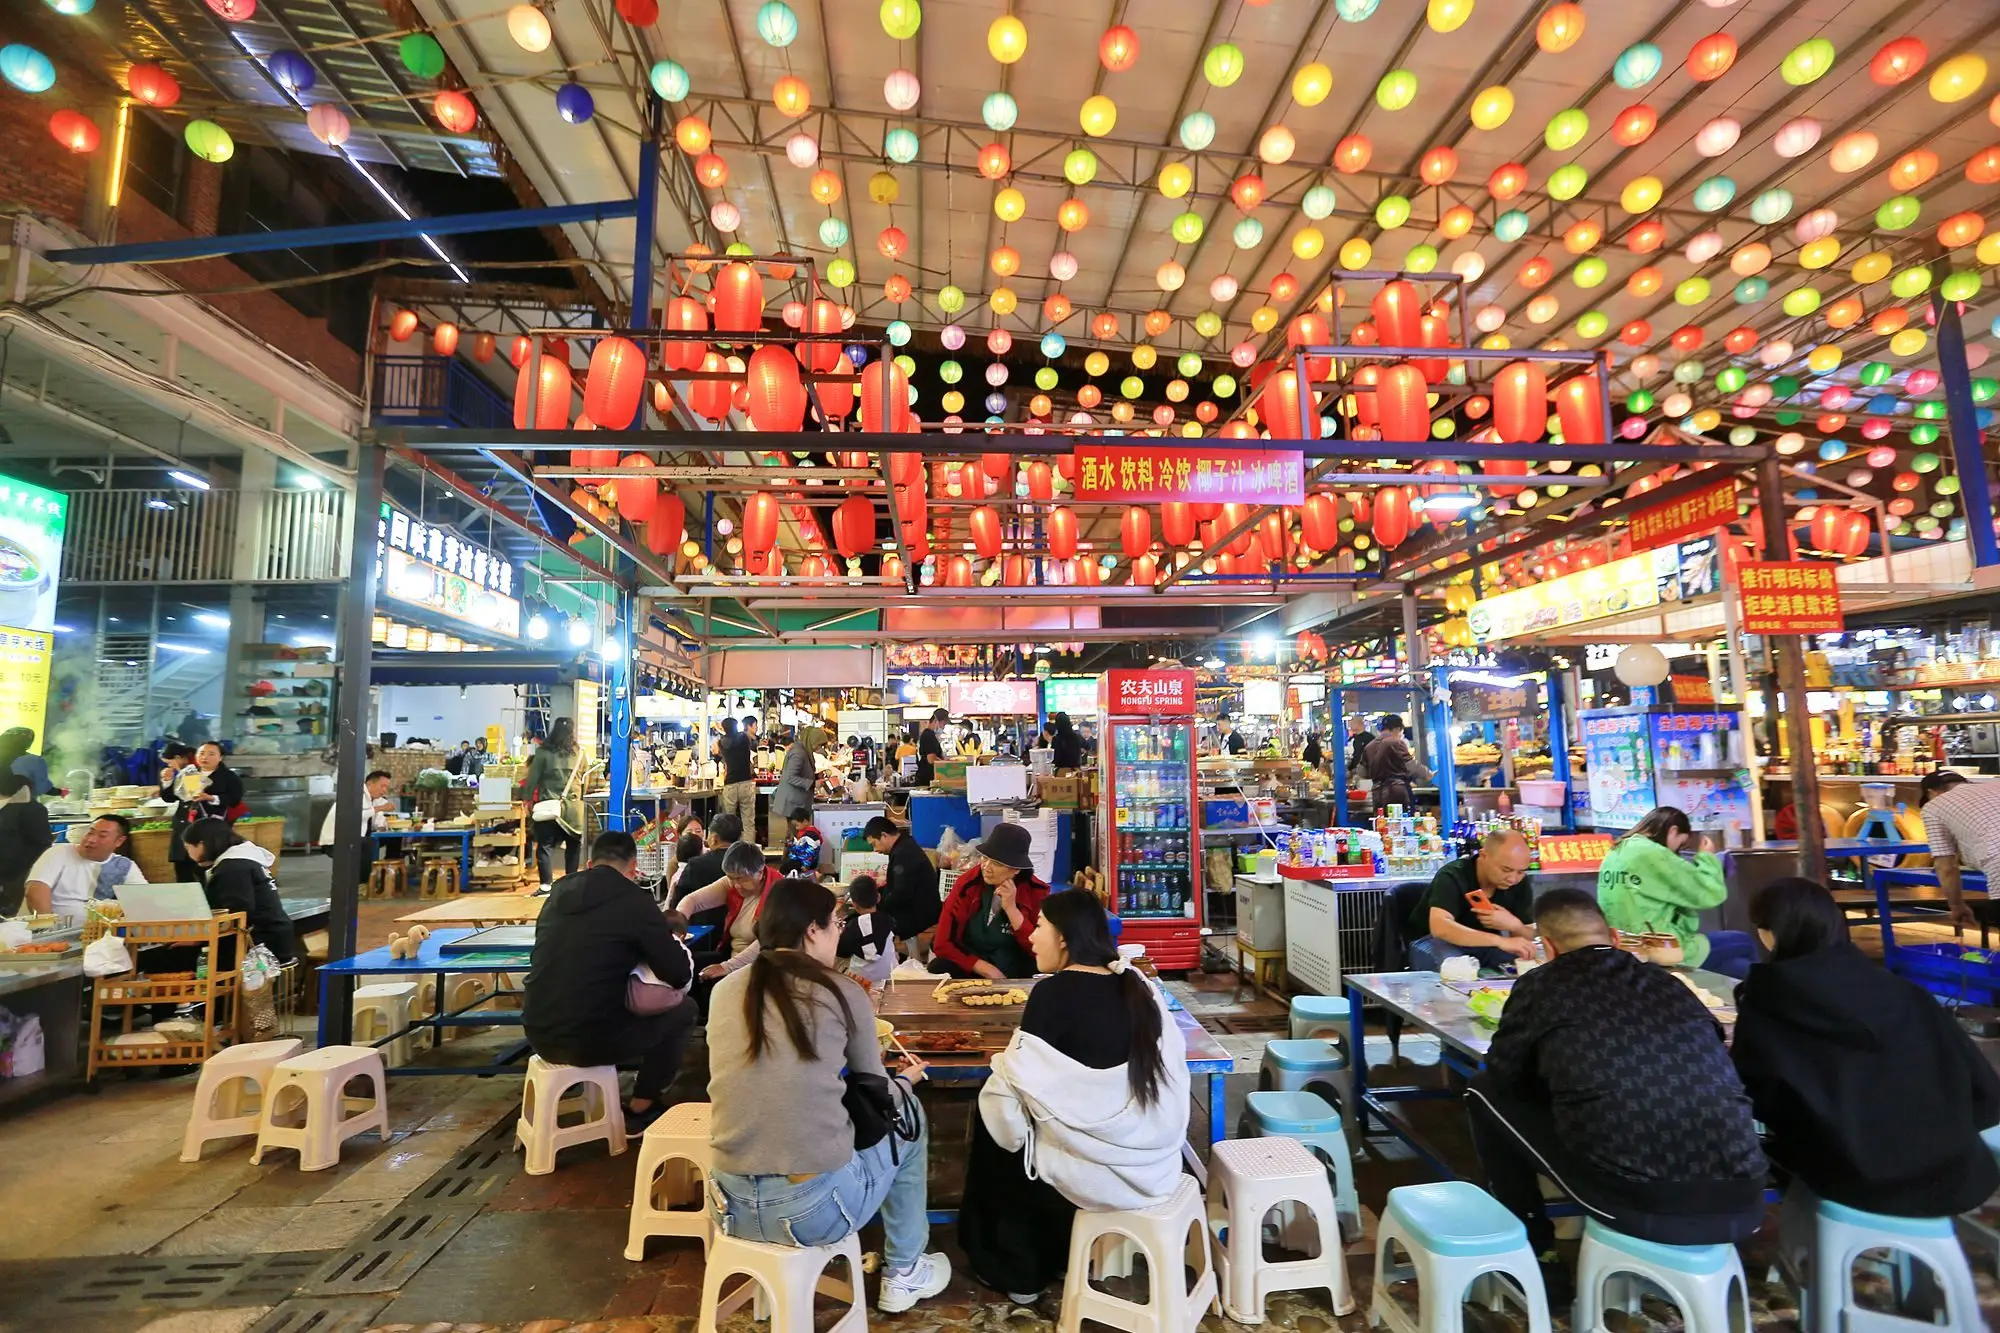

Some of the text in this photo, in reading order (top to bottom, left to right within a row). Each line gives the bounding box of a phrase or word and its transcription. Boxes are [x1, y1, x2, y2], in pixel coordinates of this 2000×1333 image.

[1081, 456, 1299, 495] 酒水 饮料 冷饮 椰子汁 冰啤酒
[1740, 567, 1833, 589] 推行明码标价
[1744, 594, 1838, 616] 拒绝消费欺诈
[1120, 678, 1183, 695] 农夫山泉
[1120, 695, 1183, 705] NONGFU SPRING
